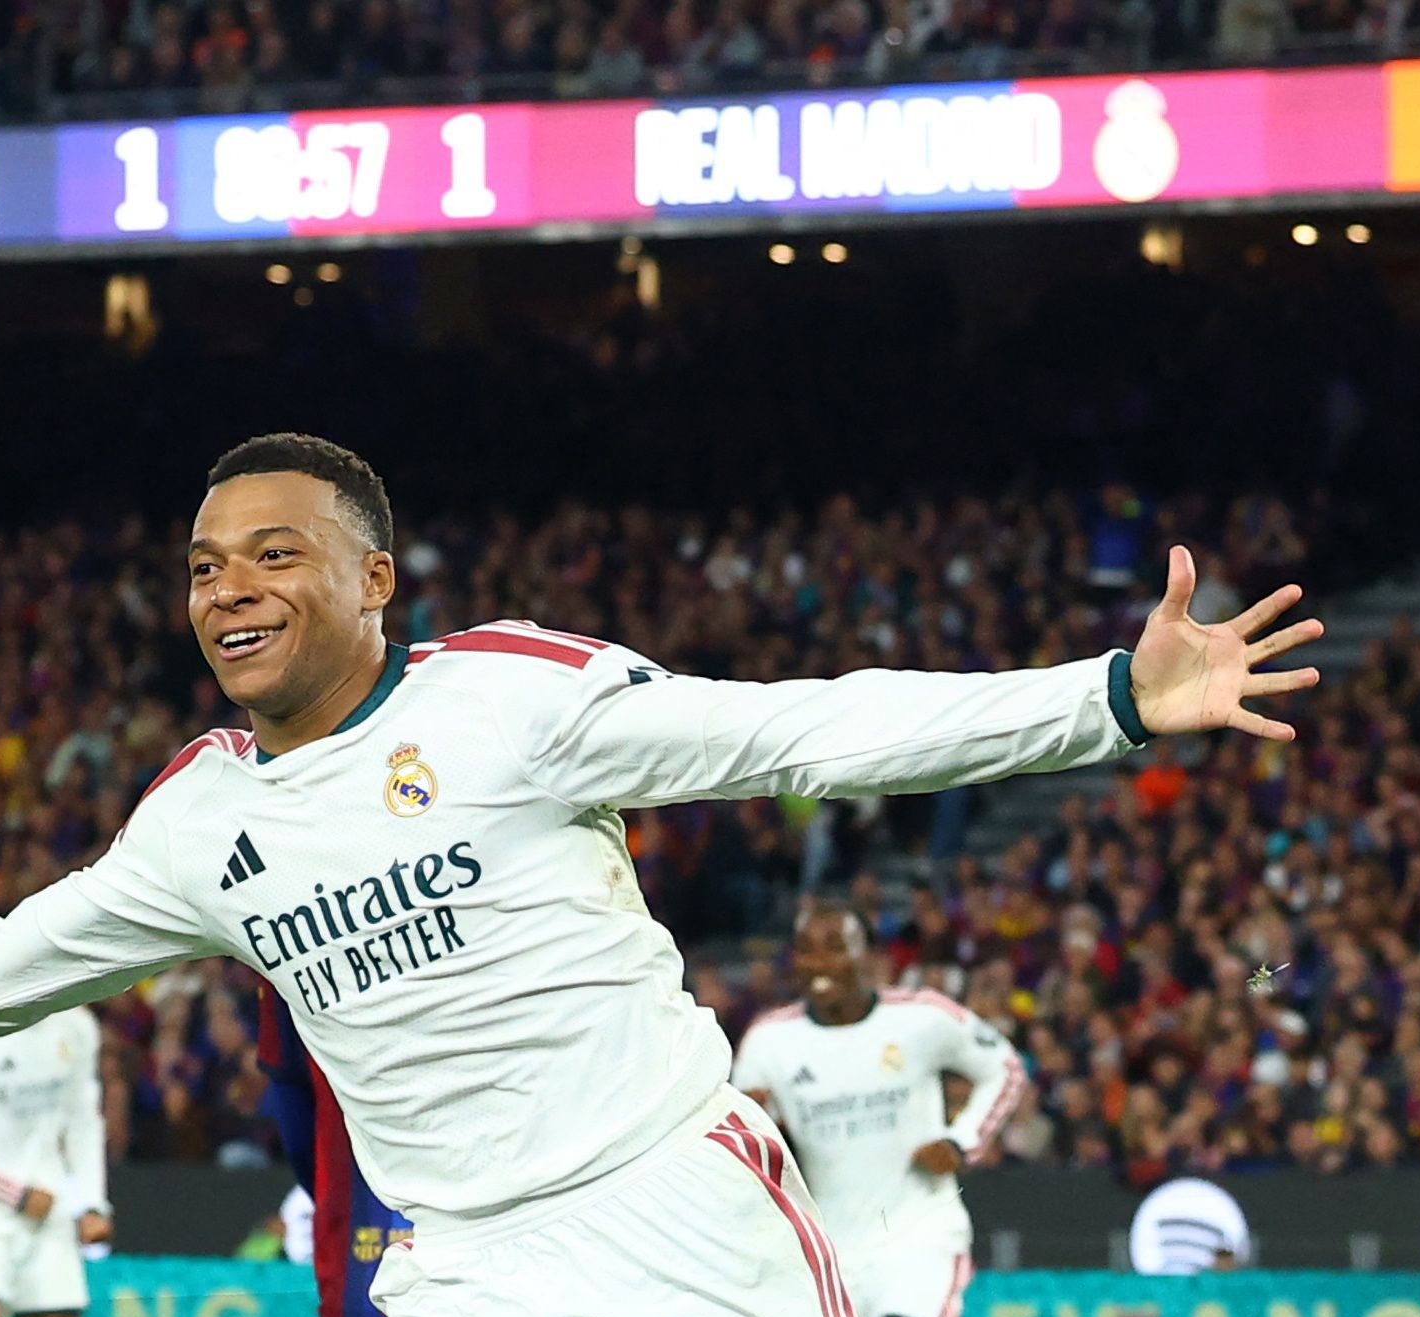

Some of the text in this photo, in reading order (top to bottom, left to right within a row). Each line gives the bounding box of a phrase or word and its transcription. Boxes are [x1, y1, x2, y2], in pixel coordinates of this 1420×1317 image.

[114, 126, 169, 231] 1
[441, 112, 497, 218] 1
[241, 841, 482, 972] Emirates
[293, 905, 466, 1016] FLY BETTER
